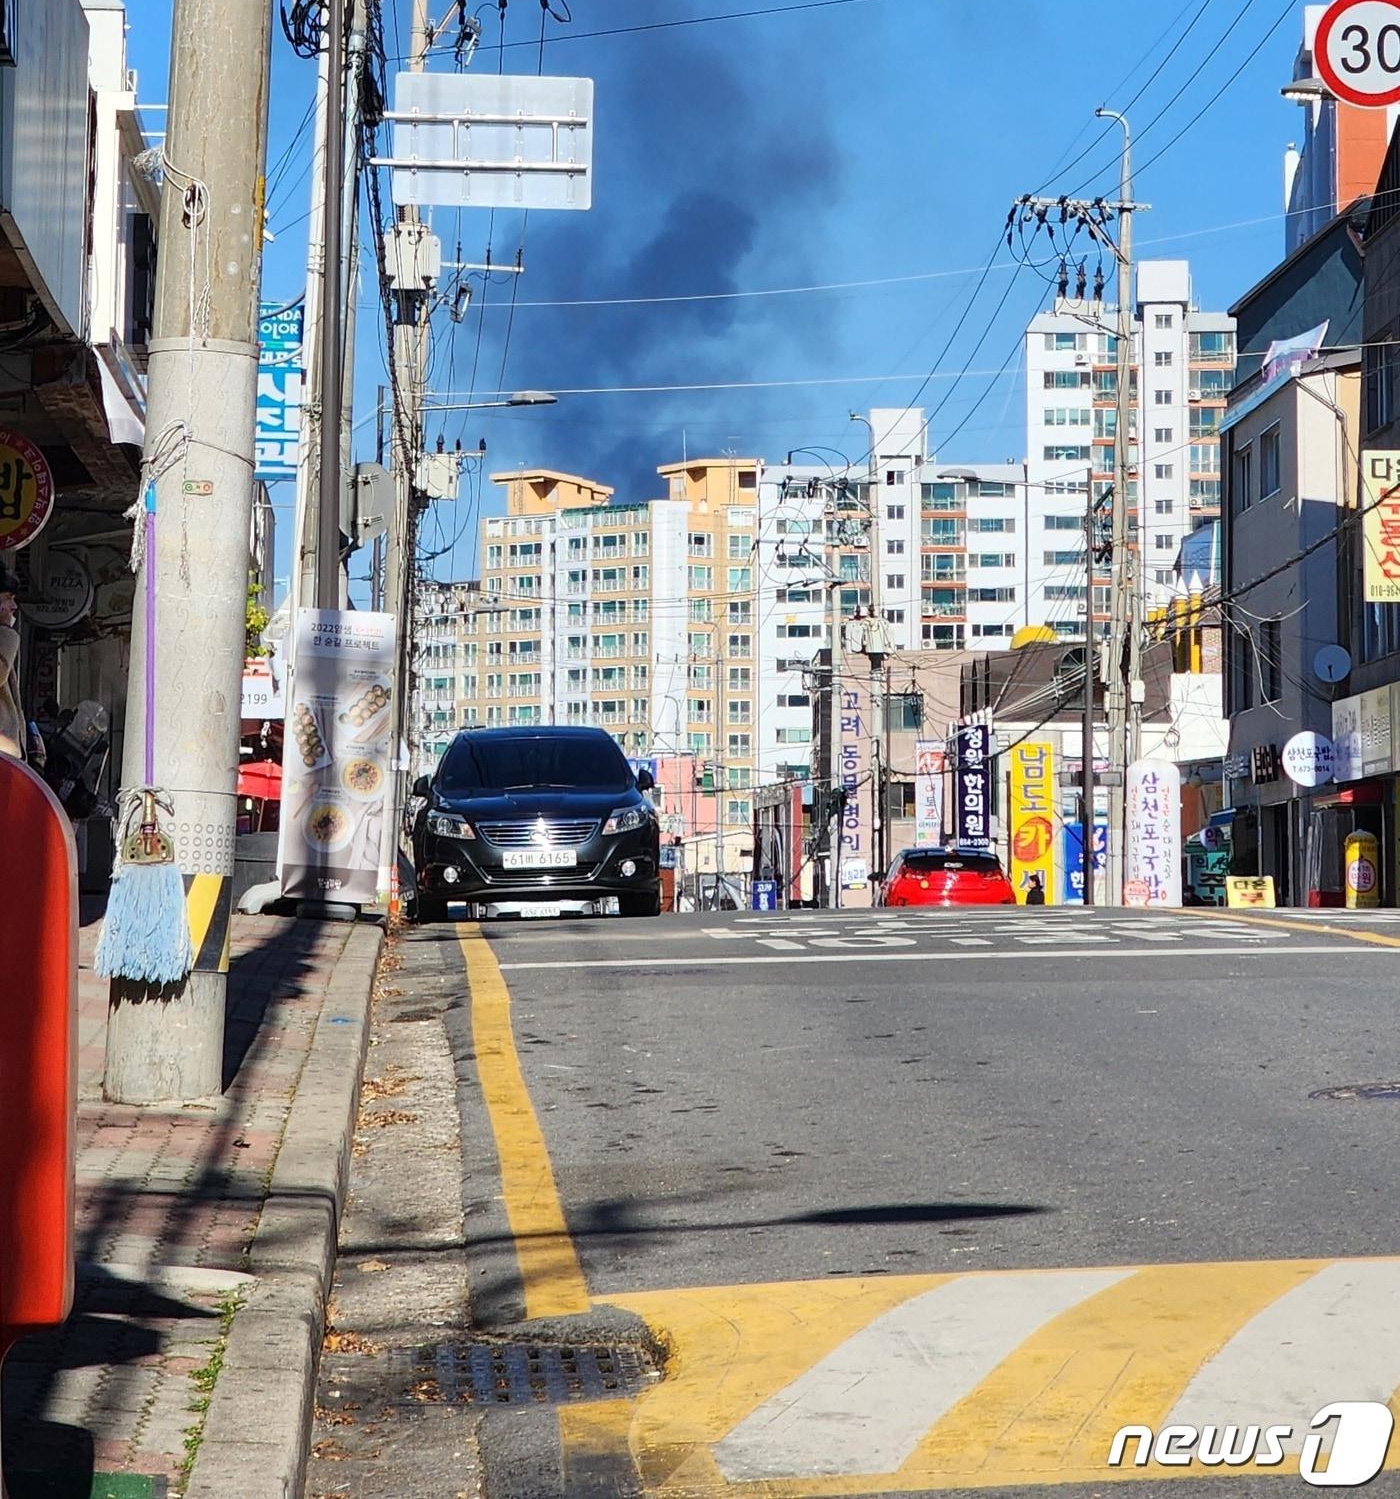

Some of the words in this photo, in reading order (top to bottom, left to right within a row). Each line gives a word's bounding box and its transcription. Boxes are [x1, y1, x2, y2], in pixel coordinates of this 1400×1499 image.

[1341, 24, 1400, 73] 30
[260, 322, 299, 339] OLOR
[50, 576, 84, 589] PIZZA
[1141, 771, 1163, 900] 삼천포국밥
[539, 852, 570, 865] 6165
